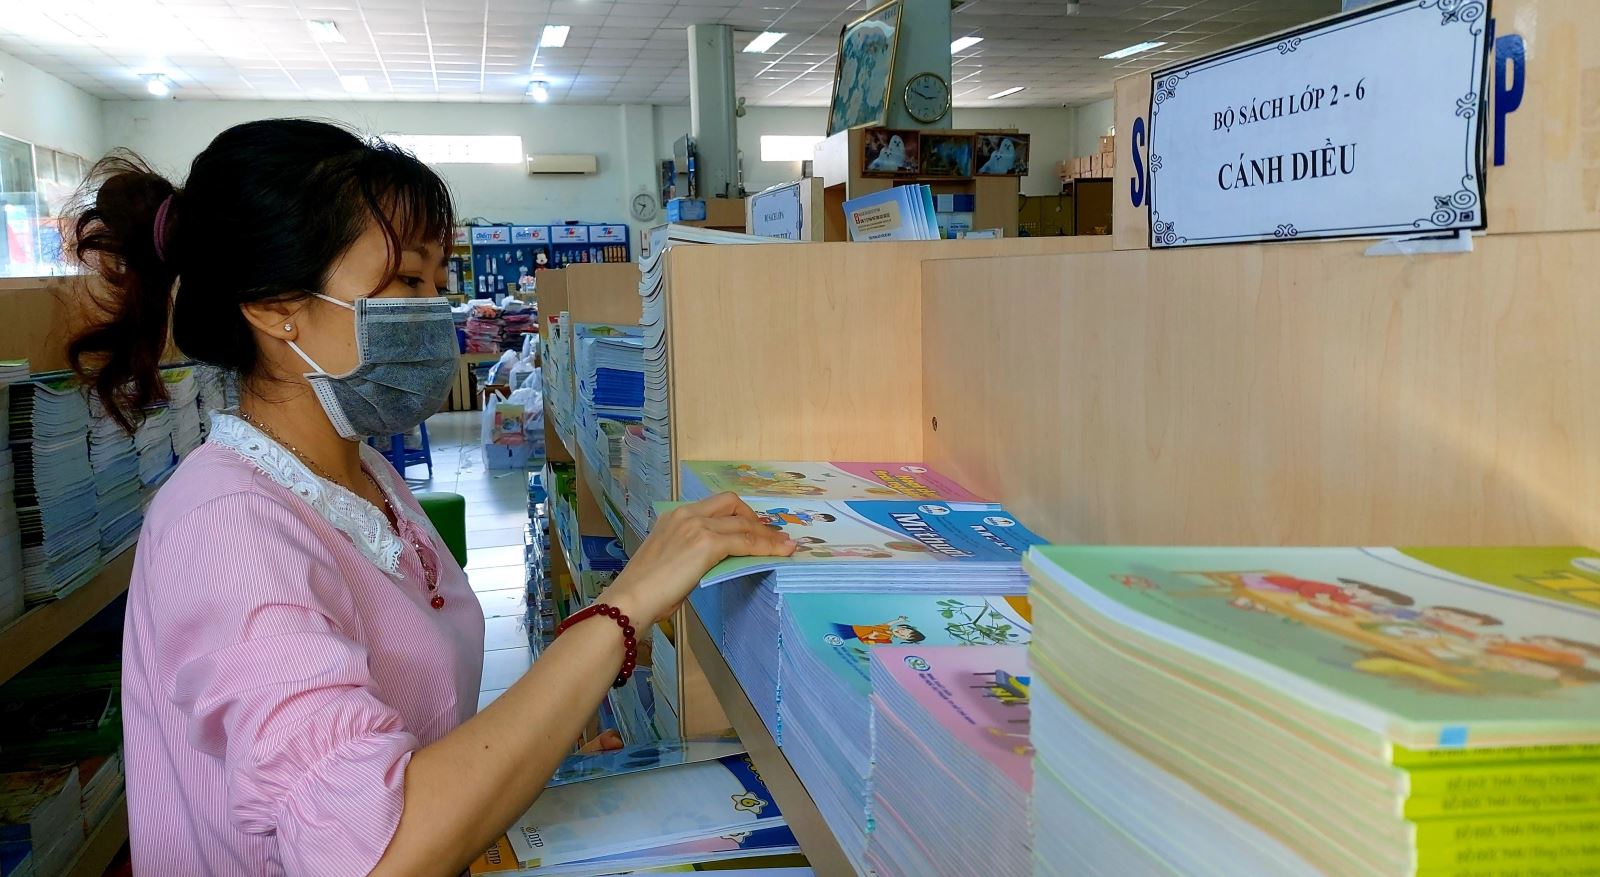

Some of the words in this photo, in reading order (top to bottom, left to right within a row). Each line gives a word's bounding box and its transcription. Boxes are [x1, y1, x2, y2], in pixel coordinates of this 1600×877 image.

[1213, 106, 1235, 133] BỘ
[1238, 97, 1284, 126] SÁCH
[1288, 84, 1325, 116] LỚP
[1329, 84, 1339, 106] 2
[1355, 77, 1366, 101] 6
[1489, 19, 1525, 166] P
[1131, 116, 1150, 207] S
[1218, 152, 1285, 191] CÁNH
[1290, 137, 1358, 182] DIỀU
